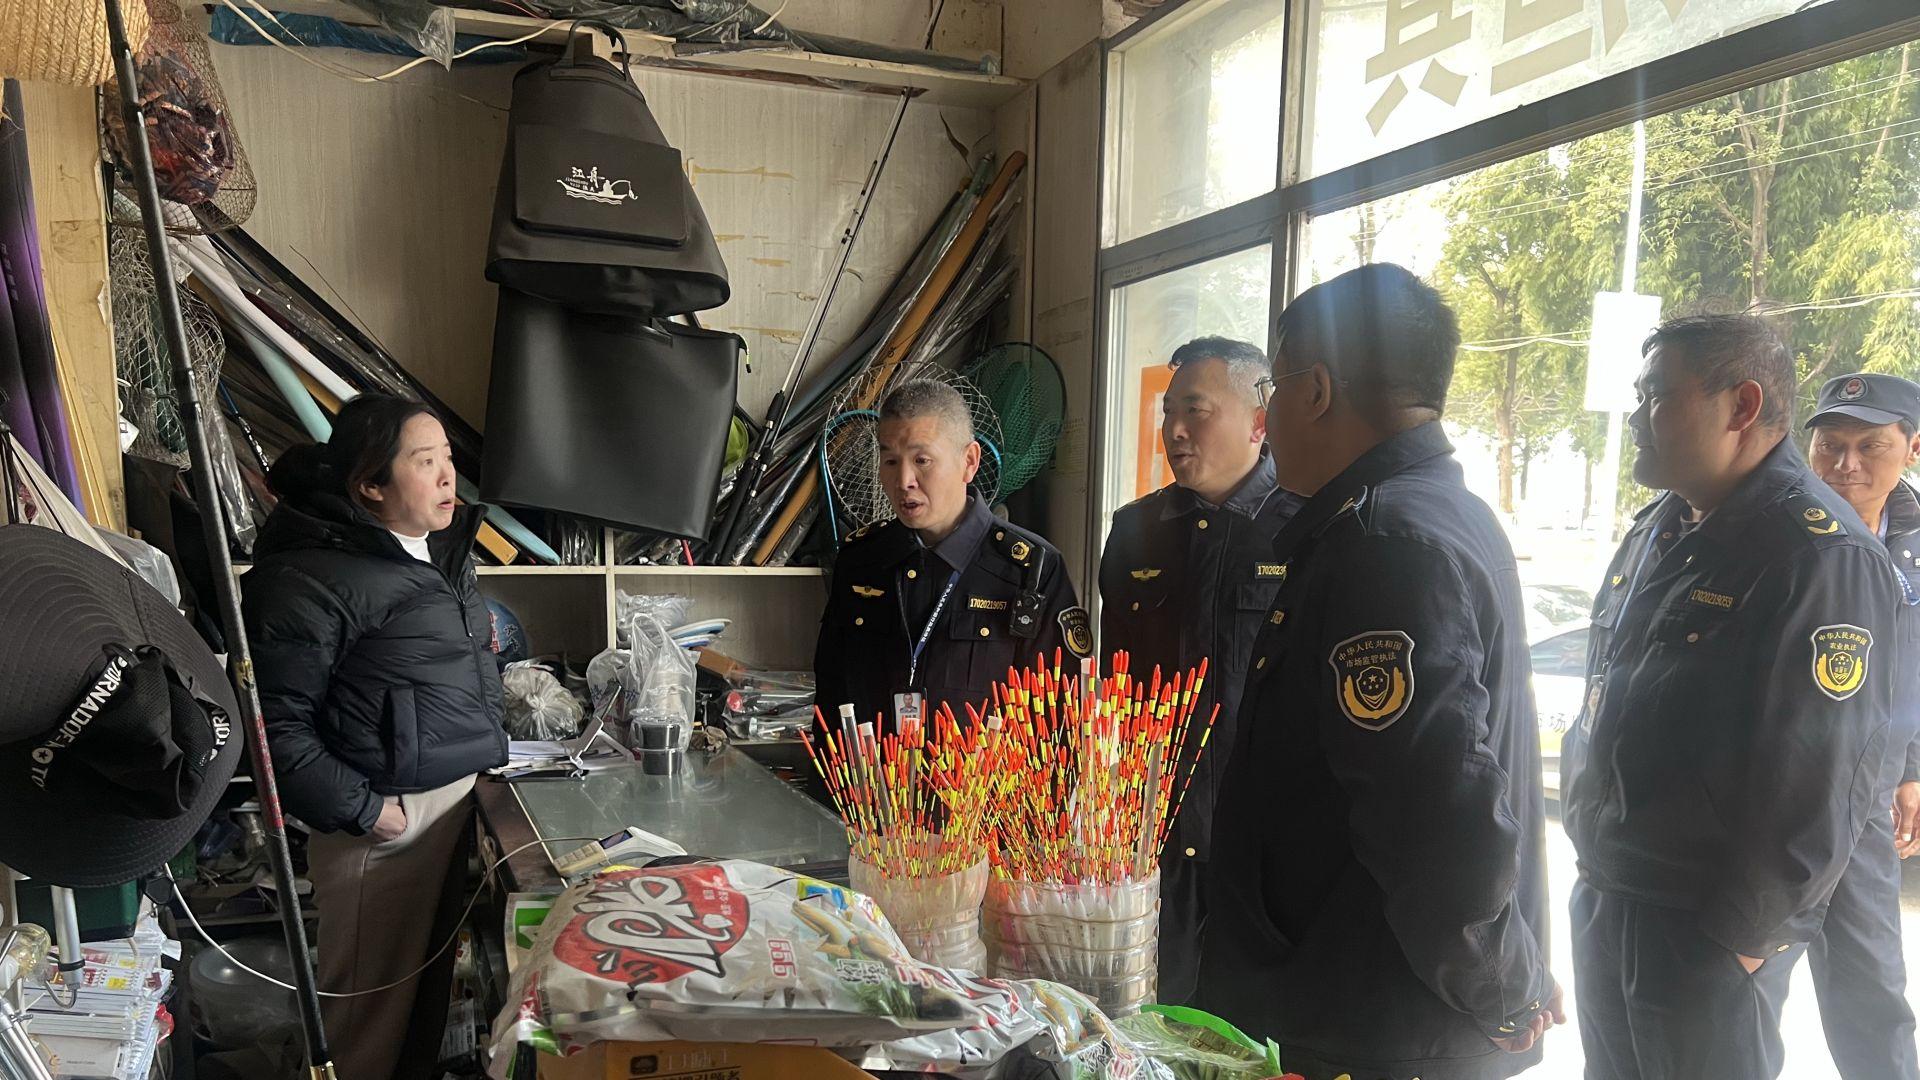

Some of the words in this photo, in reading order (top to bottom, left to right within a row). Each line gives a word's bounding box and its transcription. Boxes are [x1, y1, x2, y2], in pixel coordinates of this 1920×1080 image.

[1818, 631, 1868, 646] 中华人民共和国
[1339, 639, 1403, 661] 中华人民共和国
[1346, 652, 1397, 668] 市场监管执法
